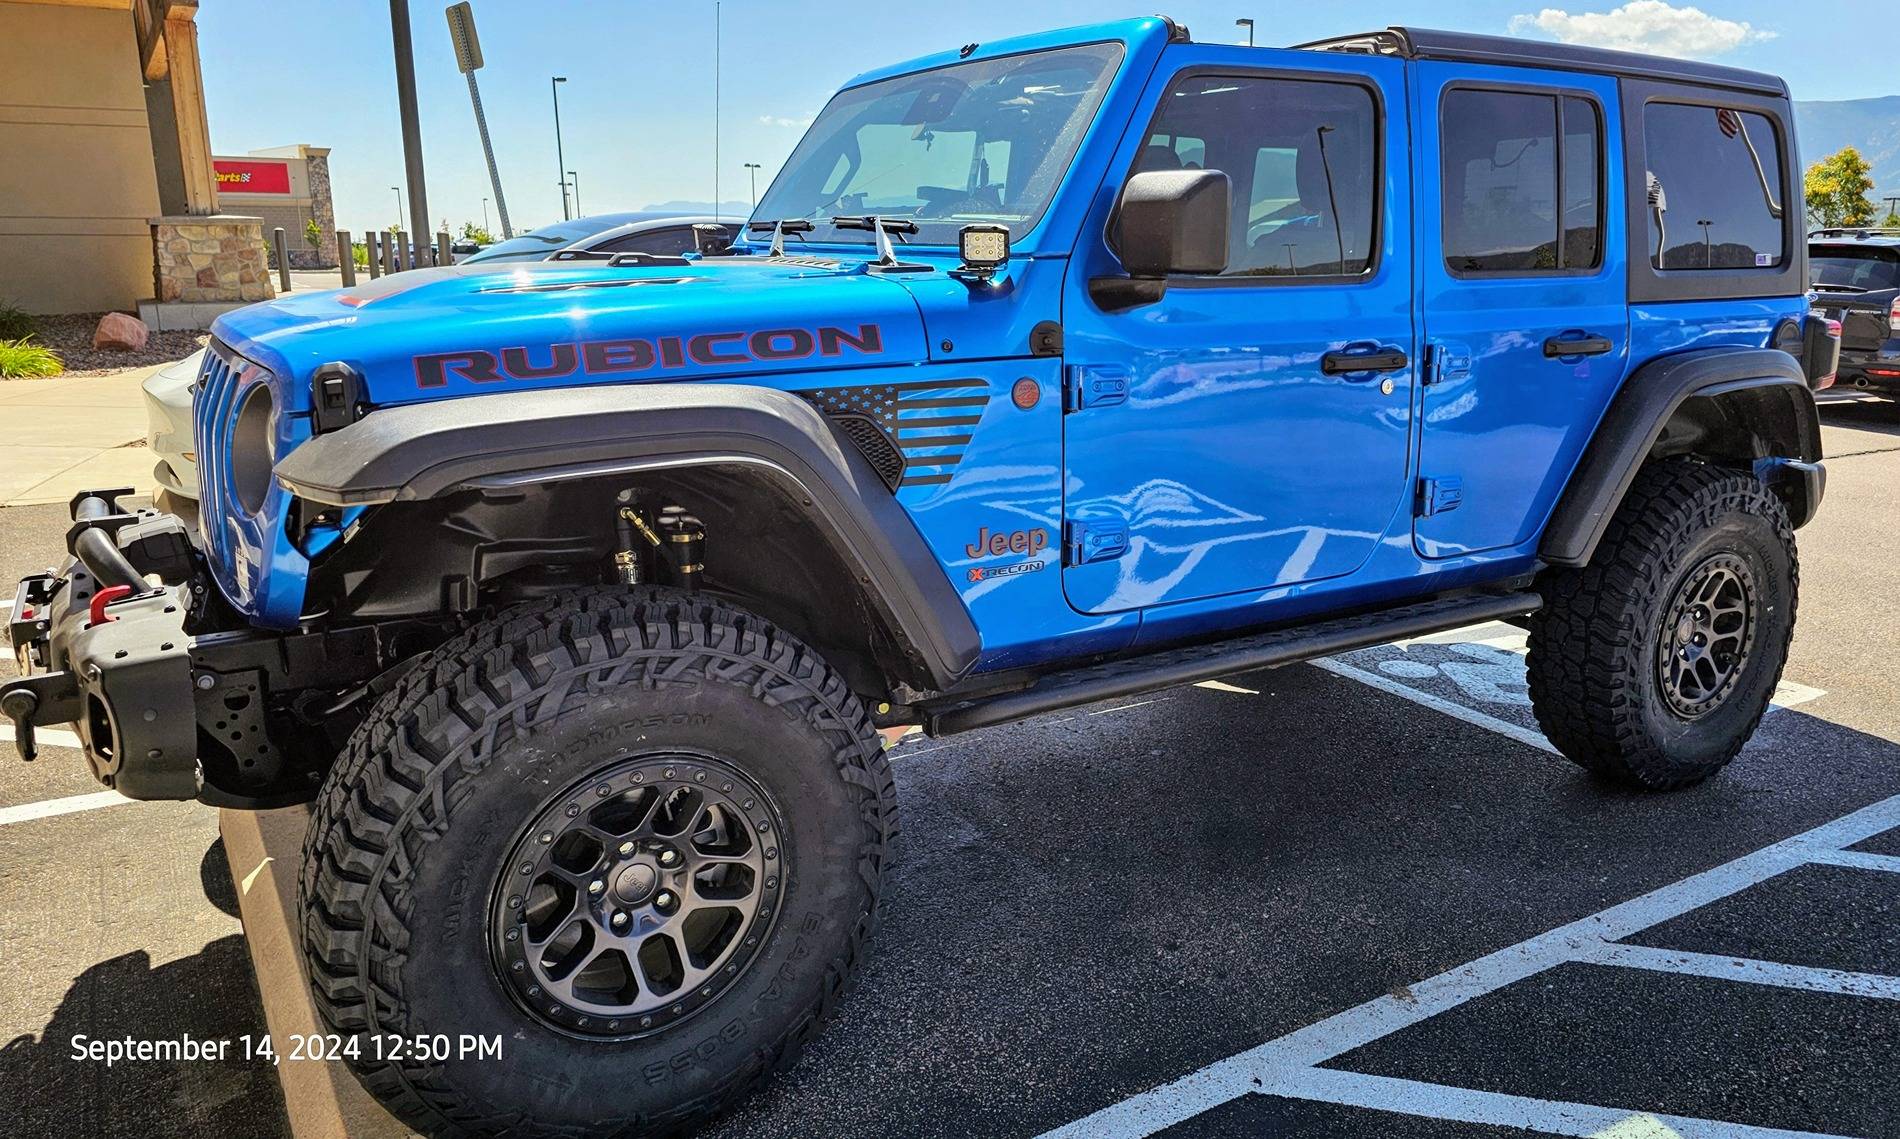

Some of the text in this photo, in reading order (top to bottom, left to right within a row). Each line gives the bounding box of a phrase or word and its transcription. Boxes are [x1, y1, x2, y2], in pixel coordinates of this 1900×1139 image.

[413, 324, 884, 389] RUBICON
[966, 526, 1048, 558] Jeep
[624, 872, 648, 893] Jeep
[641, 1015, 748, 1087] BOSS
